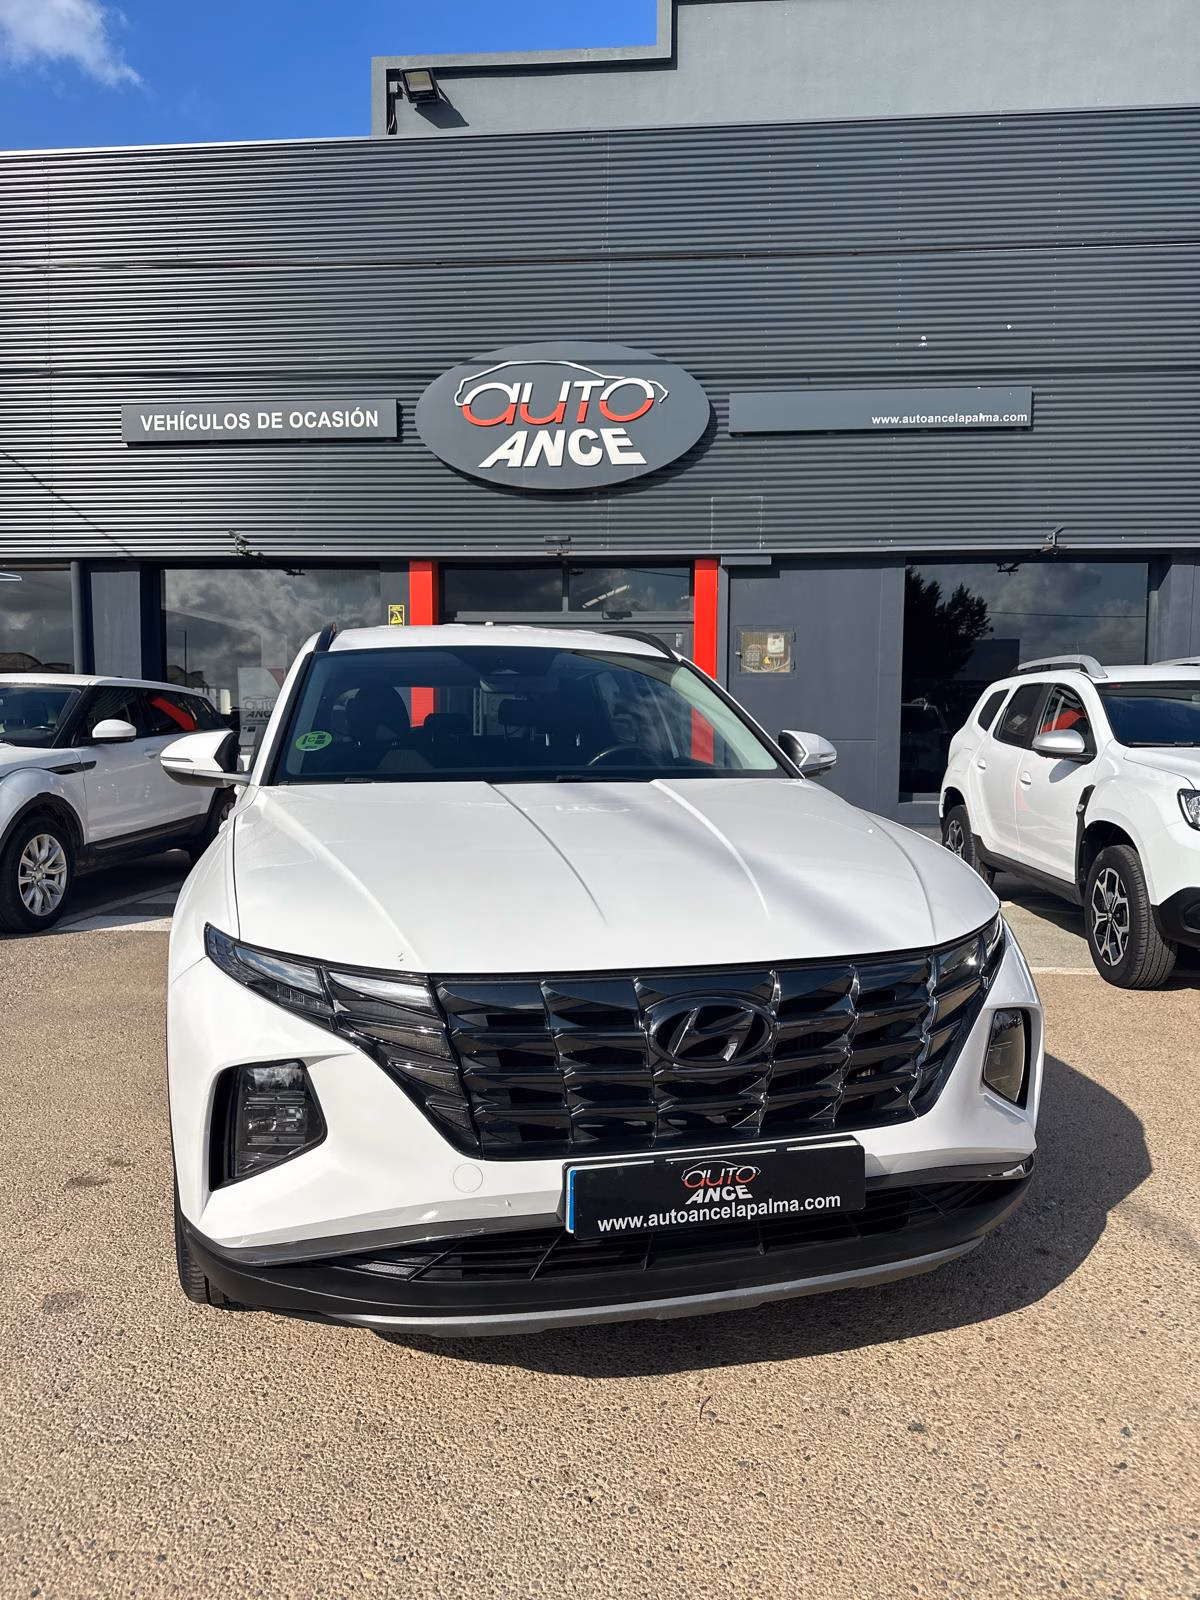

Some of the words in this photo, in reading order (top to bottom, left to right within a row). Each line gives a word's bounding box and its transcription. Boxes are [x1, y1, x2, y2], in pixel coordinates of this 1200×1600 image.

[140, 411, 250, 431] VEHÍCULOS
[257, 412, 283, 429] DE
[289, 408, 379, 428] OCASIÓN
[871, 412, 1028, 425] www.autoancelapalma.com
[478, 428, 647, 468] ANCE
[685, 1185, 753, 1205] ANCE
[597, 1194, 842, 1232] www.autoancelapalma.com
